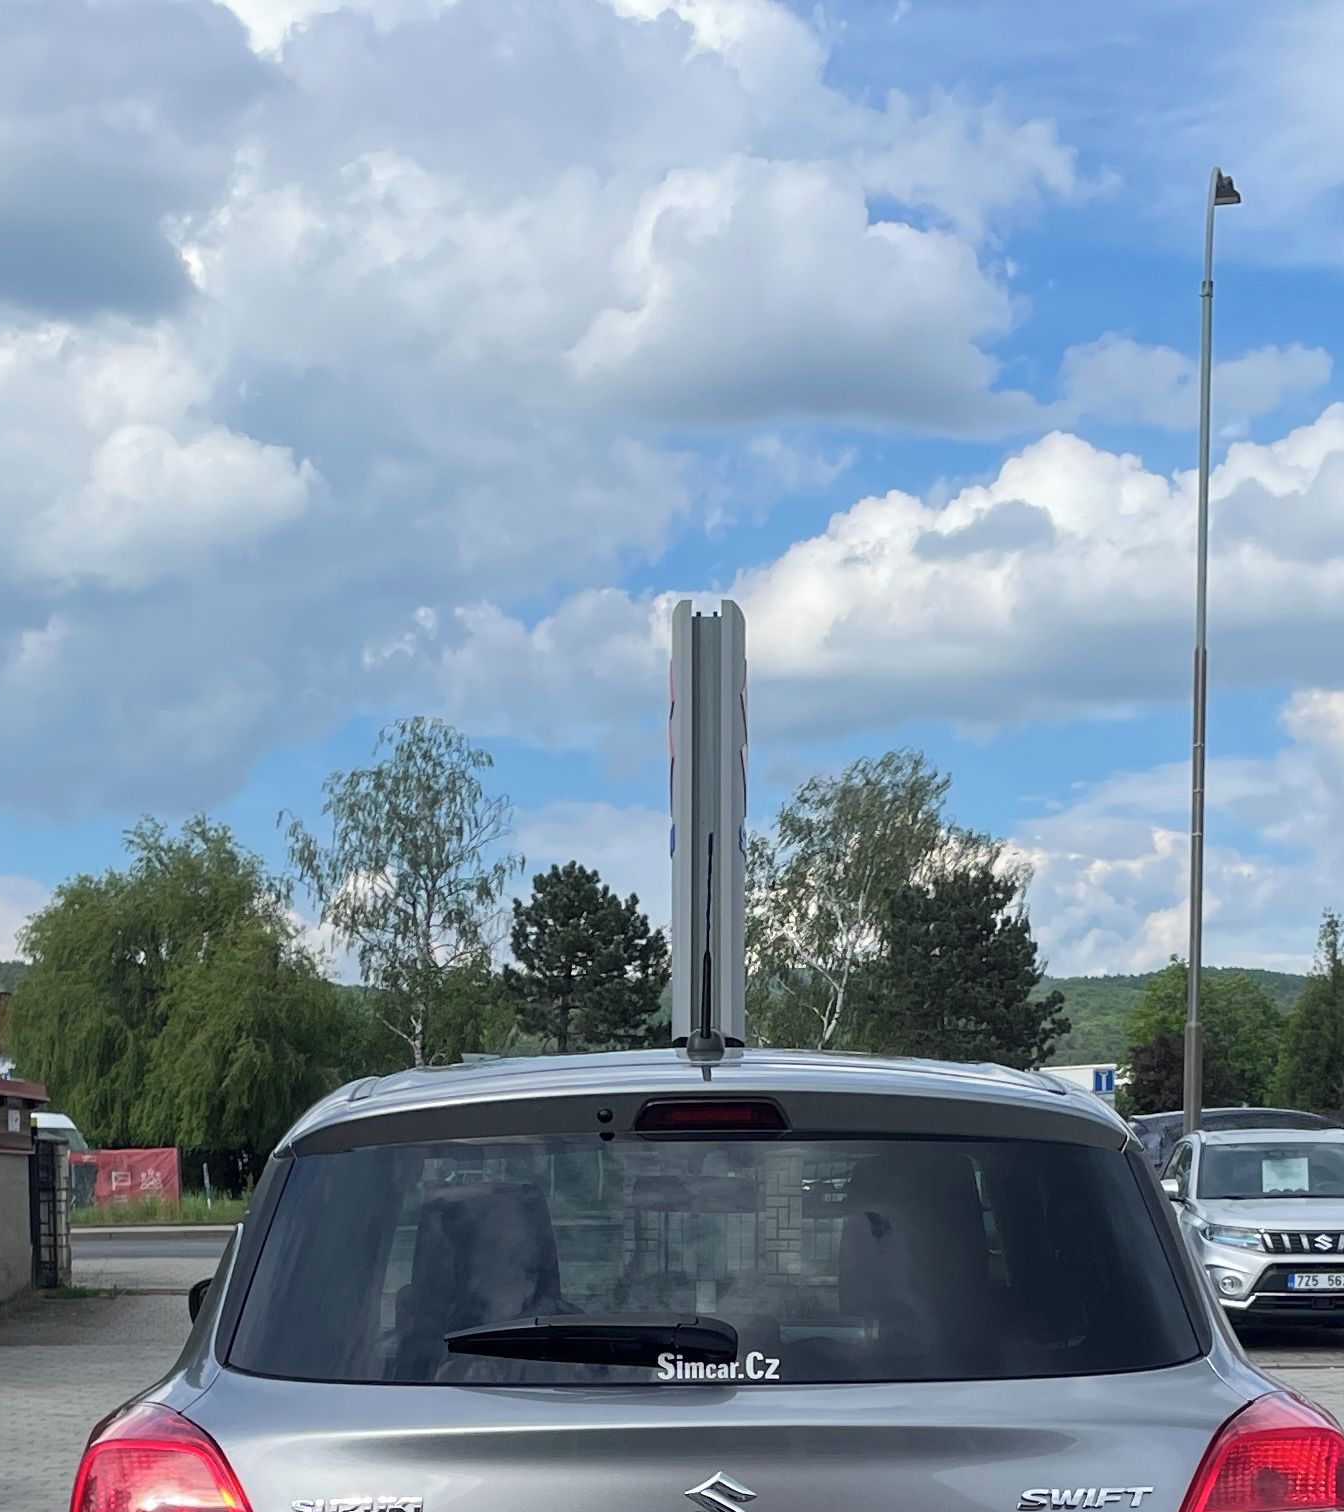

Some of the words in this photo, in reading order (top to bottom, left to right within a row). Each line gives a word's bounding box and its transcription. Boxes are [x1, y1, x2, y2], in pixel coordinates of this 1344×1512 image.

[1297, 1274, 1319, 1287] 7Z5
[657, 1351, 780, 1380] Simcar.Cz
[1016, 1485, 1154, 1511] SWIFT
